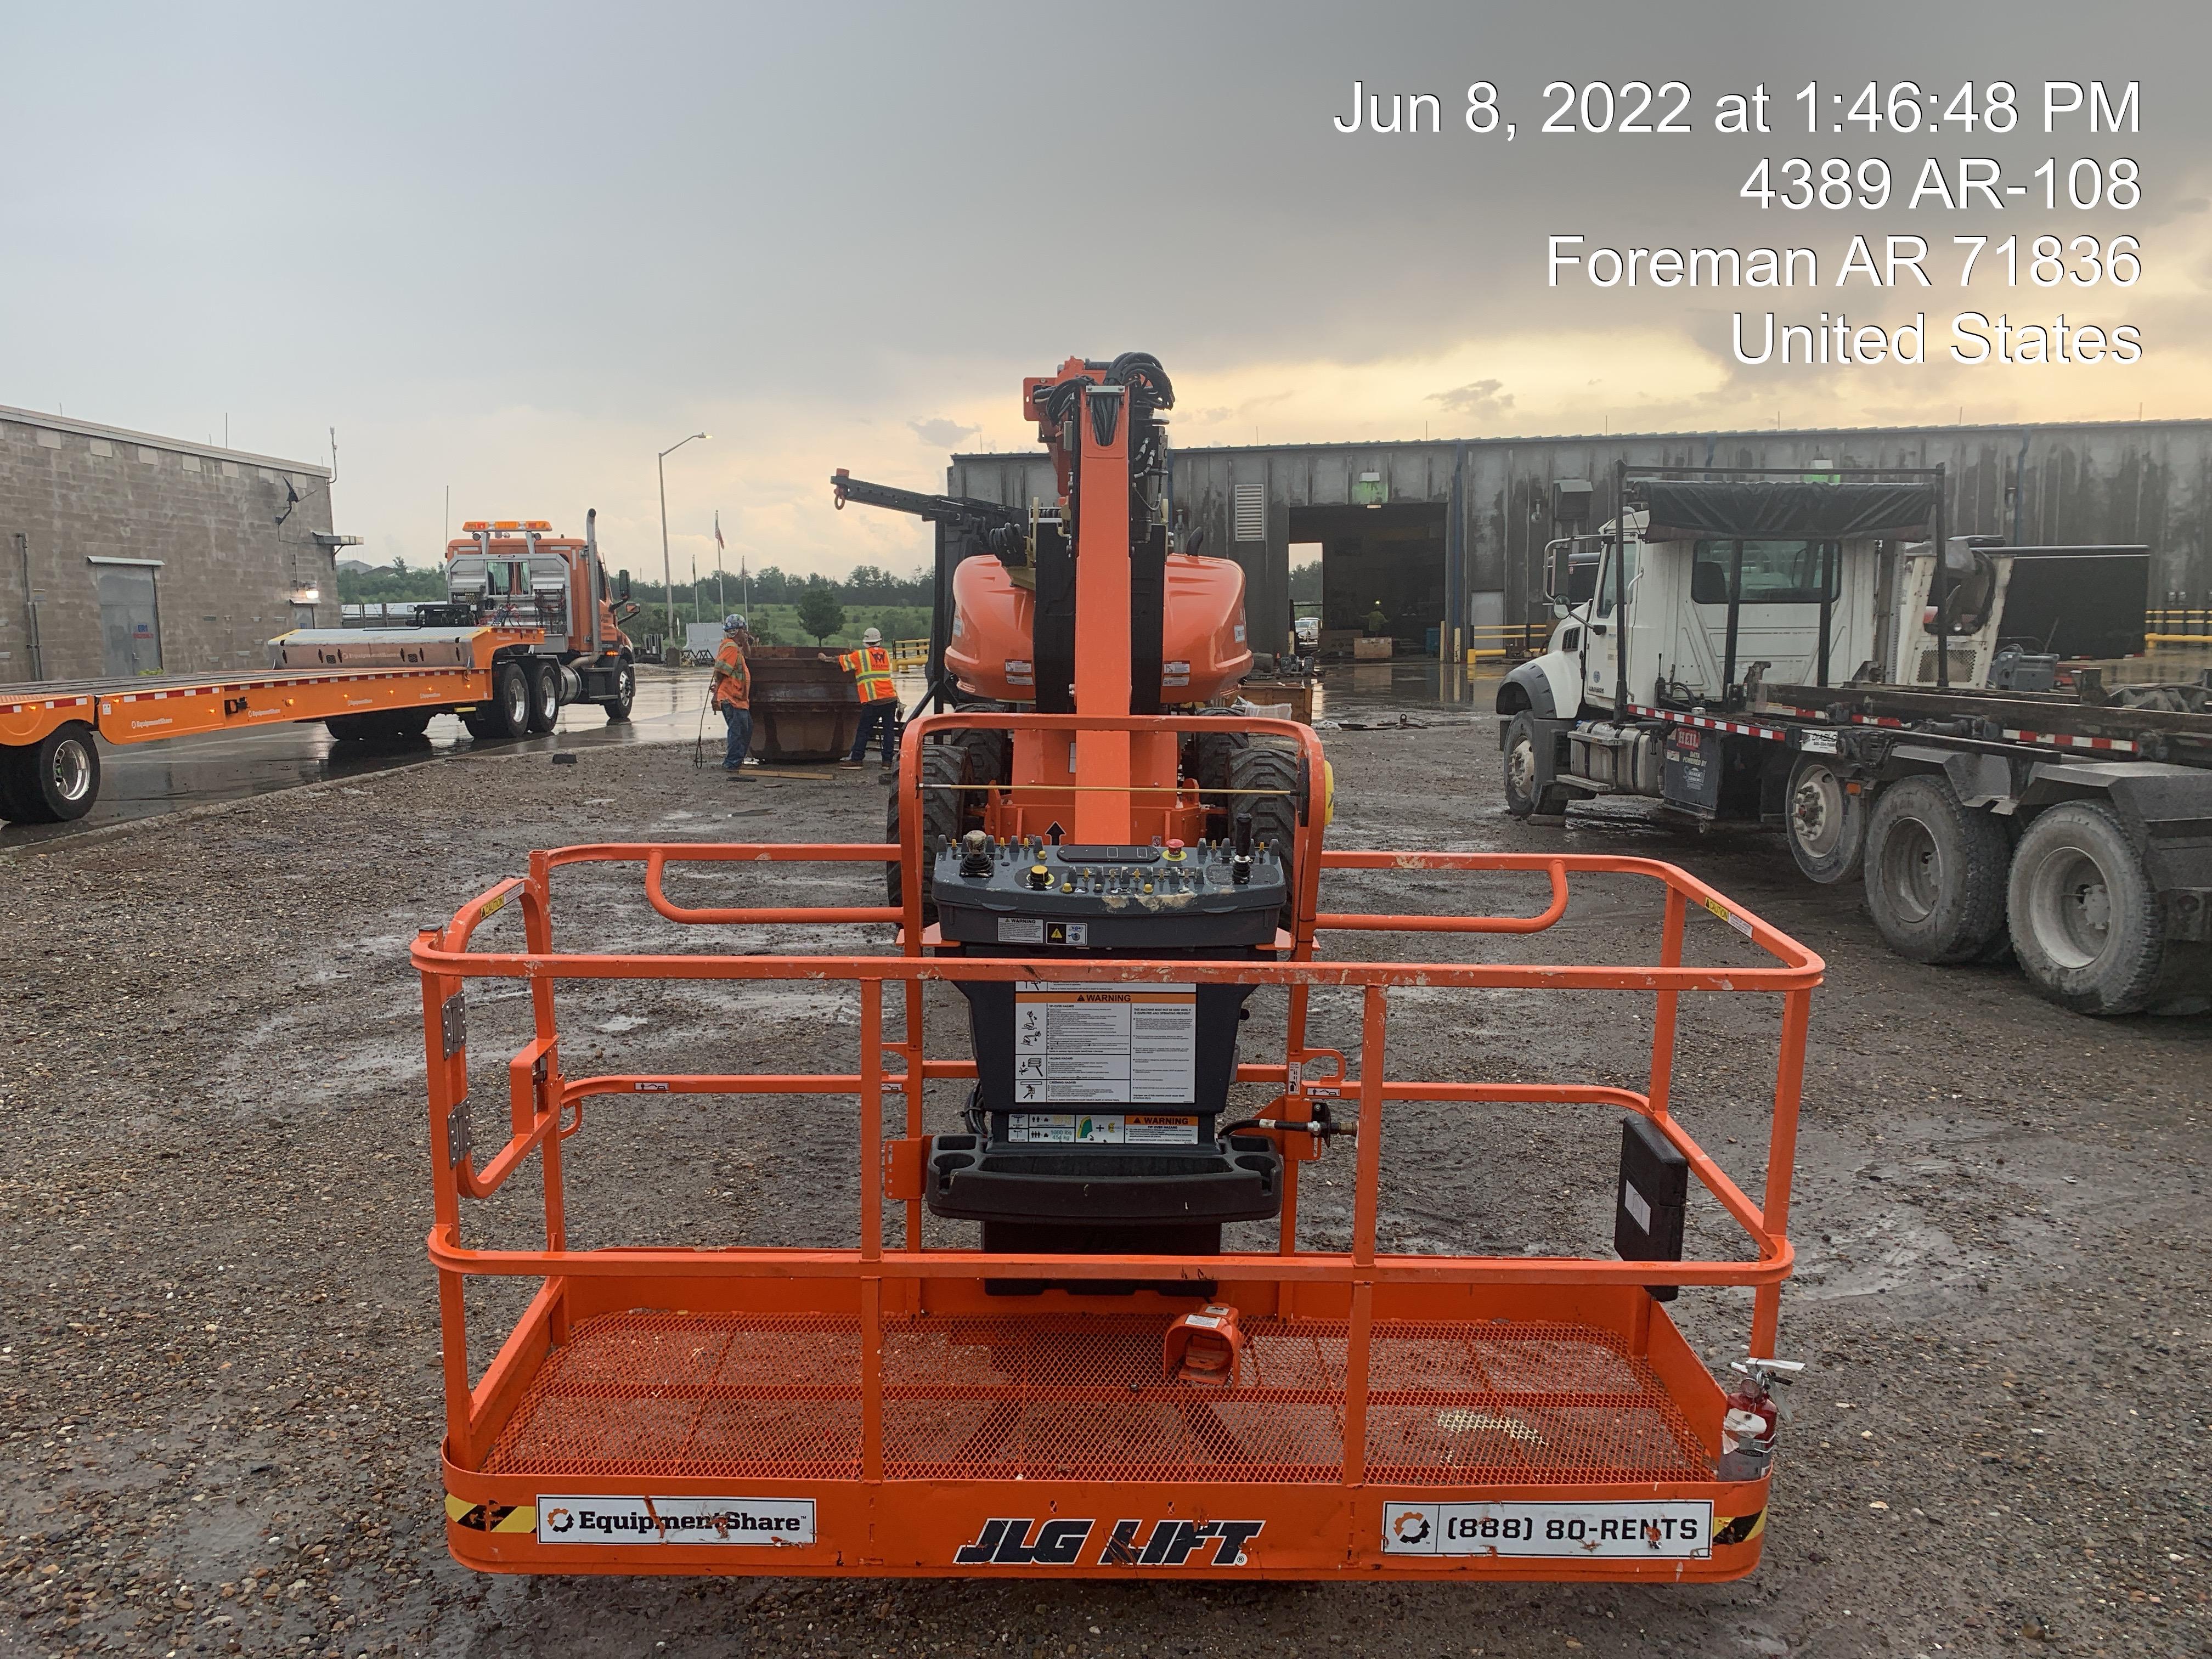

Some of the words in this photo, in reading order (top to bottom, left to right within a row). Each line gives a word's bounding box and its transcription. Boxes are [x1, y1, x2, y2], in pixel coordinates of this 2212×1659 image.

[1678, 731, 1699, 748] HEIL
[486, 898, 504, 914] CAUTION
[1709, 901, 1728, 919] CAUTION
[1086, 994, 1131, 1002] WARNING
[578, 1510, 801, 1533] EquipmentShare
[1447, 1517, 1533, 1541] (888)
[1545, 1517, 1699, 1541] 80-RENTS
[953, 1517, 1096, 1565] JLG
[1097, 1519, 1266, 1566] LIFT
